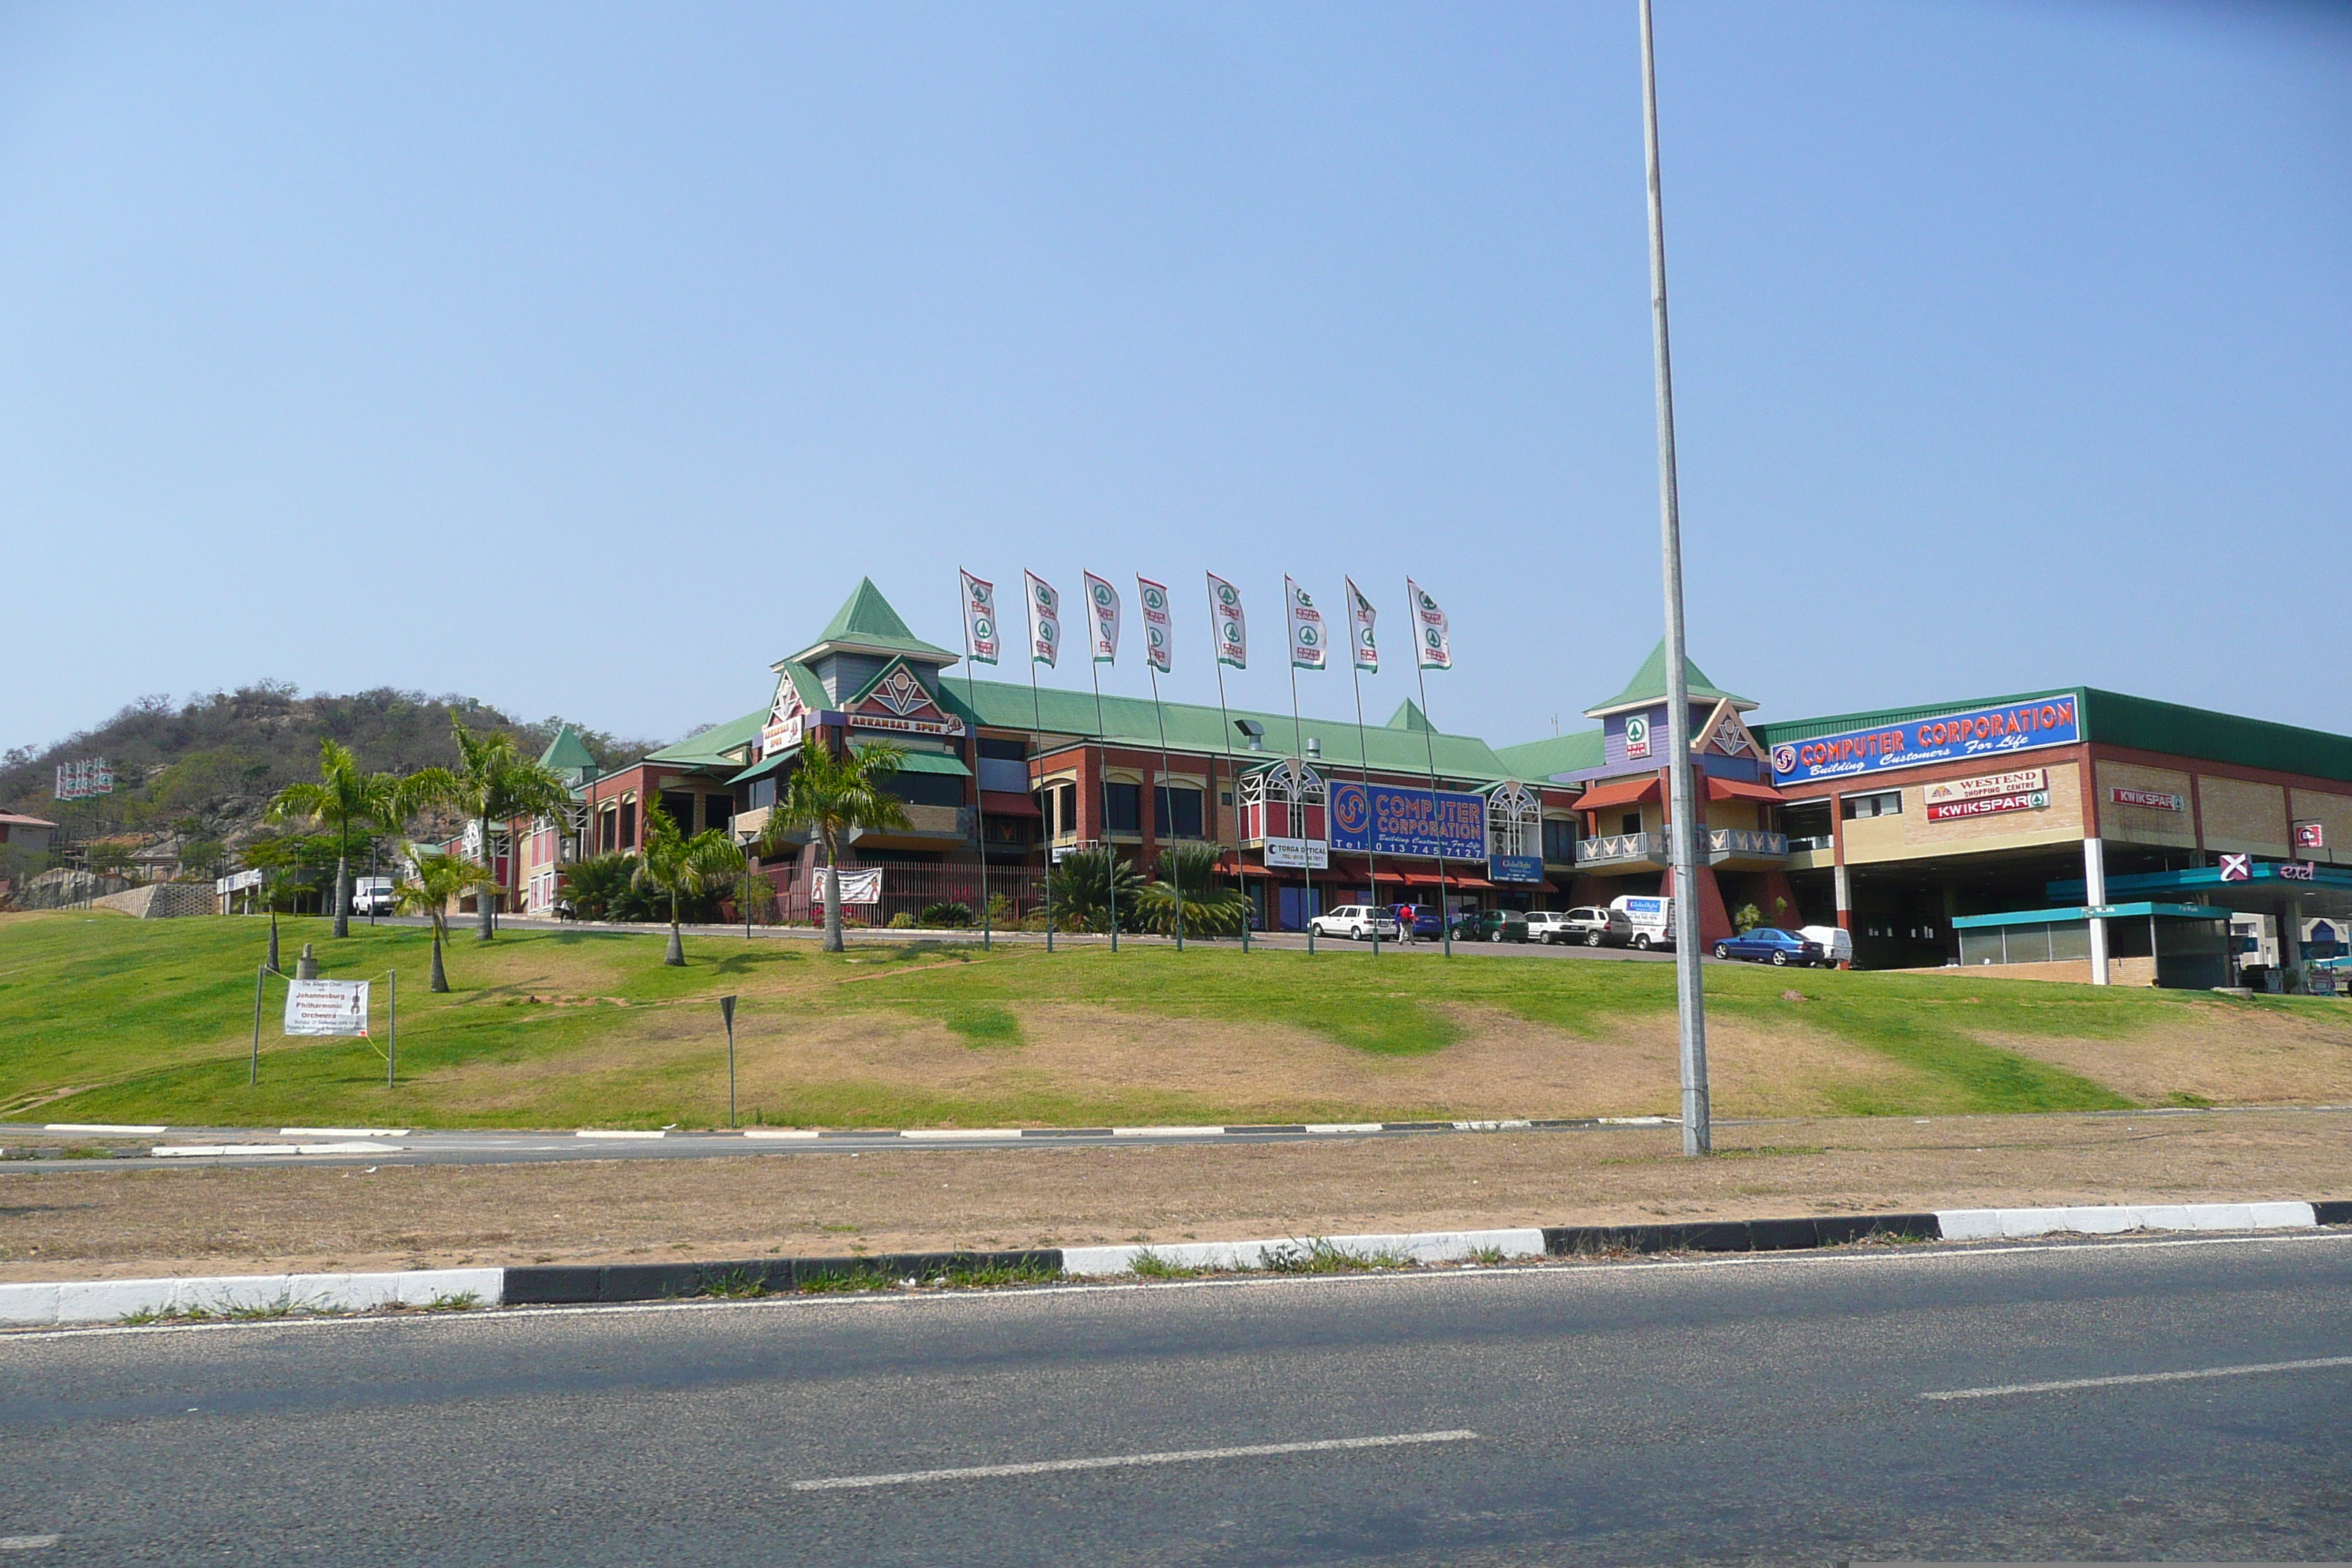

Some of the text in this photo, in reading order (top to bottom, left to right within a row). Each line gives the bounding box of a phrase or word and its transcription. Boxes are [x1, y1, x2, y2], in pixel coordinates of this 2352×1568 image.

[1298, 652, 1319, 660] SPAR
[1299, 647, 1319, 655] KWIK
[852, 716, 942, 733] ARKANSAS SPUR
[1801, 702, 2073, 766] COMPUTER CORPORATION
[1809, 734, 2029, 776] Building Customers For Life
[1960, 772, 2037, 790] WESTEND
[1964, 782, 2035, 798] SHOPPING CENTRE
[1939, 795, 2028, 817] KWIKSPAR
[2121, 791, 2173, 807] KWIKSPAR
[1376, 794, 1480, 824] COMPUTER
[1377, 816, 1481, 840] CORPORATION
[1379, 834, 1410, 845] Building
[1451, 840, 1464, 848] For
[1466, 841, 1481, 850] Life
[1300, 847, 1327, 855] OTICAL
[1412, 845, 1439, 855] 745
[1446, 848, 1481, 858] 7127
[295, 992, 345, 1000] Johannesburg
